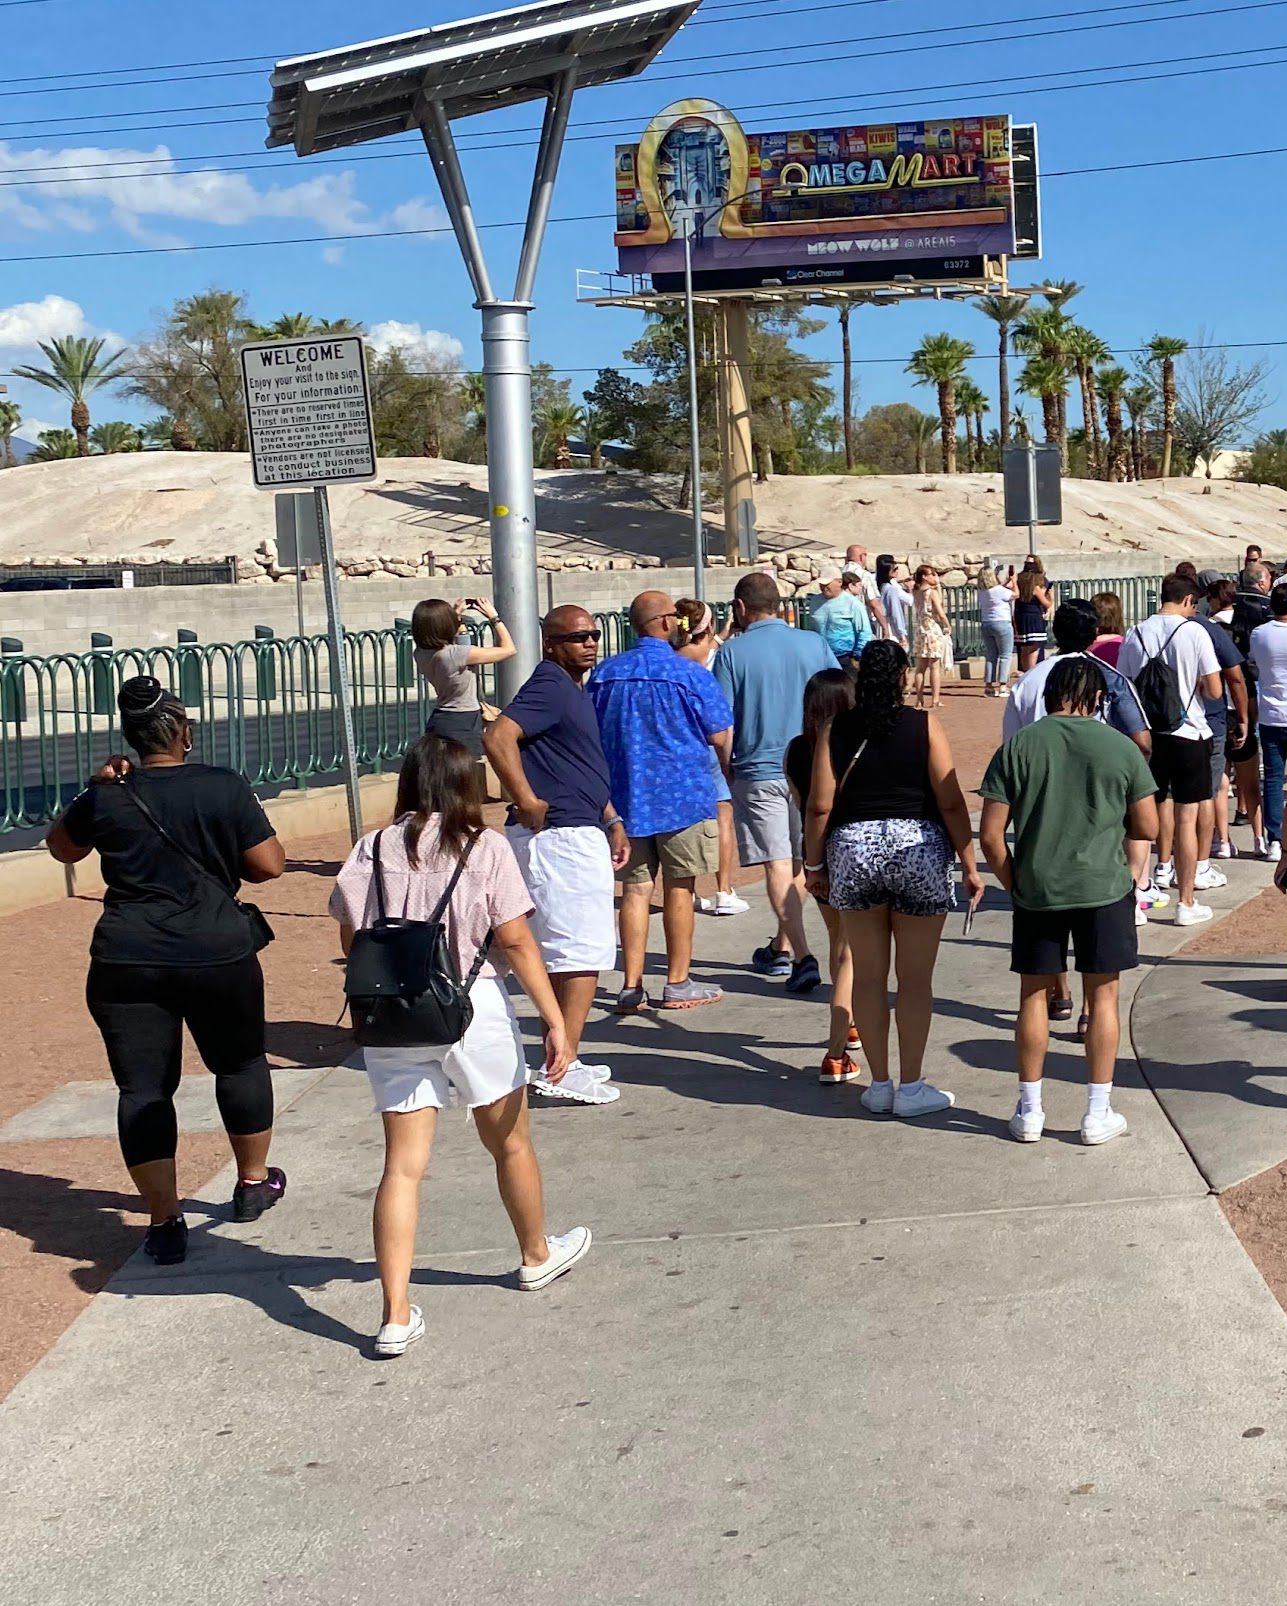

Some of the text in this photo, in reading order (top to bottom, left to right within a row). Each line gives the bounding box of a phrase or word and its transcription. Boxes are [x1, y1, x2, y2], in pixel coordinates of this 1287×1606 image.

[869, 133, 896, 144] KIWIS
[808, 241, 854, 255] MEOW
[855, 238, 899, 251] WOLF
[905, 239, 915, 249] @
[797, 269, 844, 278] Clear Channel
[260, 344, 344, 367] WELCOME
[296, 364, 312, 372] And
[250, 377, 271, 391] Enjoy
[275, 376, 293, 388] your
[296, 371, 313, 383] visit
[315, 372, 324, 381] to
[326, 370, 339, 380] the
[255, 385, 362, 403] For your information:
[256, 407, 278, 417] There
[281, 406, 294, 415] are
[309, 401, 341, 411] reserved
[343, 400, 365, 409] times
[258, 409, 365, 426] first in time first in line
[260, 428, 291, 437] Anyone
[295, 426, 309, 434] can
[342, 420, 367, 431] photo
[261, 435, 284, 443] there
[319, 428, 367, 440] designated
[261, 438, 346, 452] photographers
[262, 446, 370, 464] Vendors are not licensed
[264, 456, 371, 472] to conduct business
[264, 467, 355, 481] at this location
